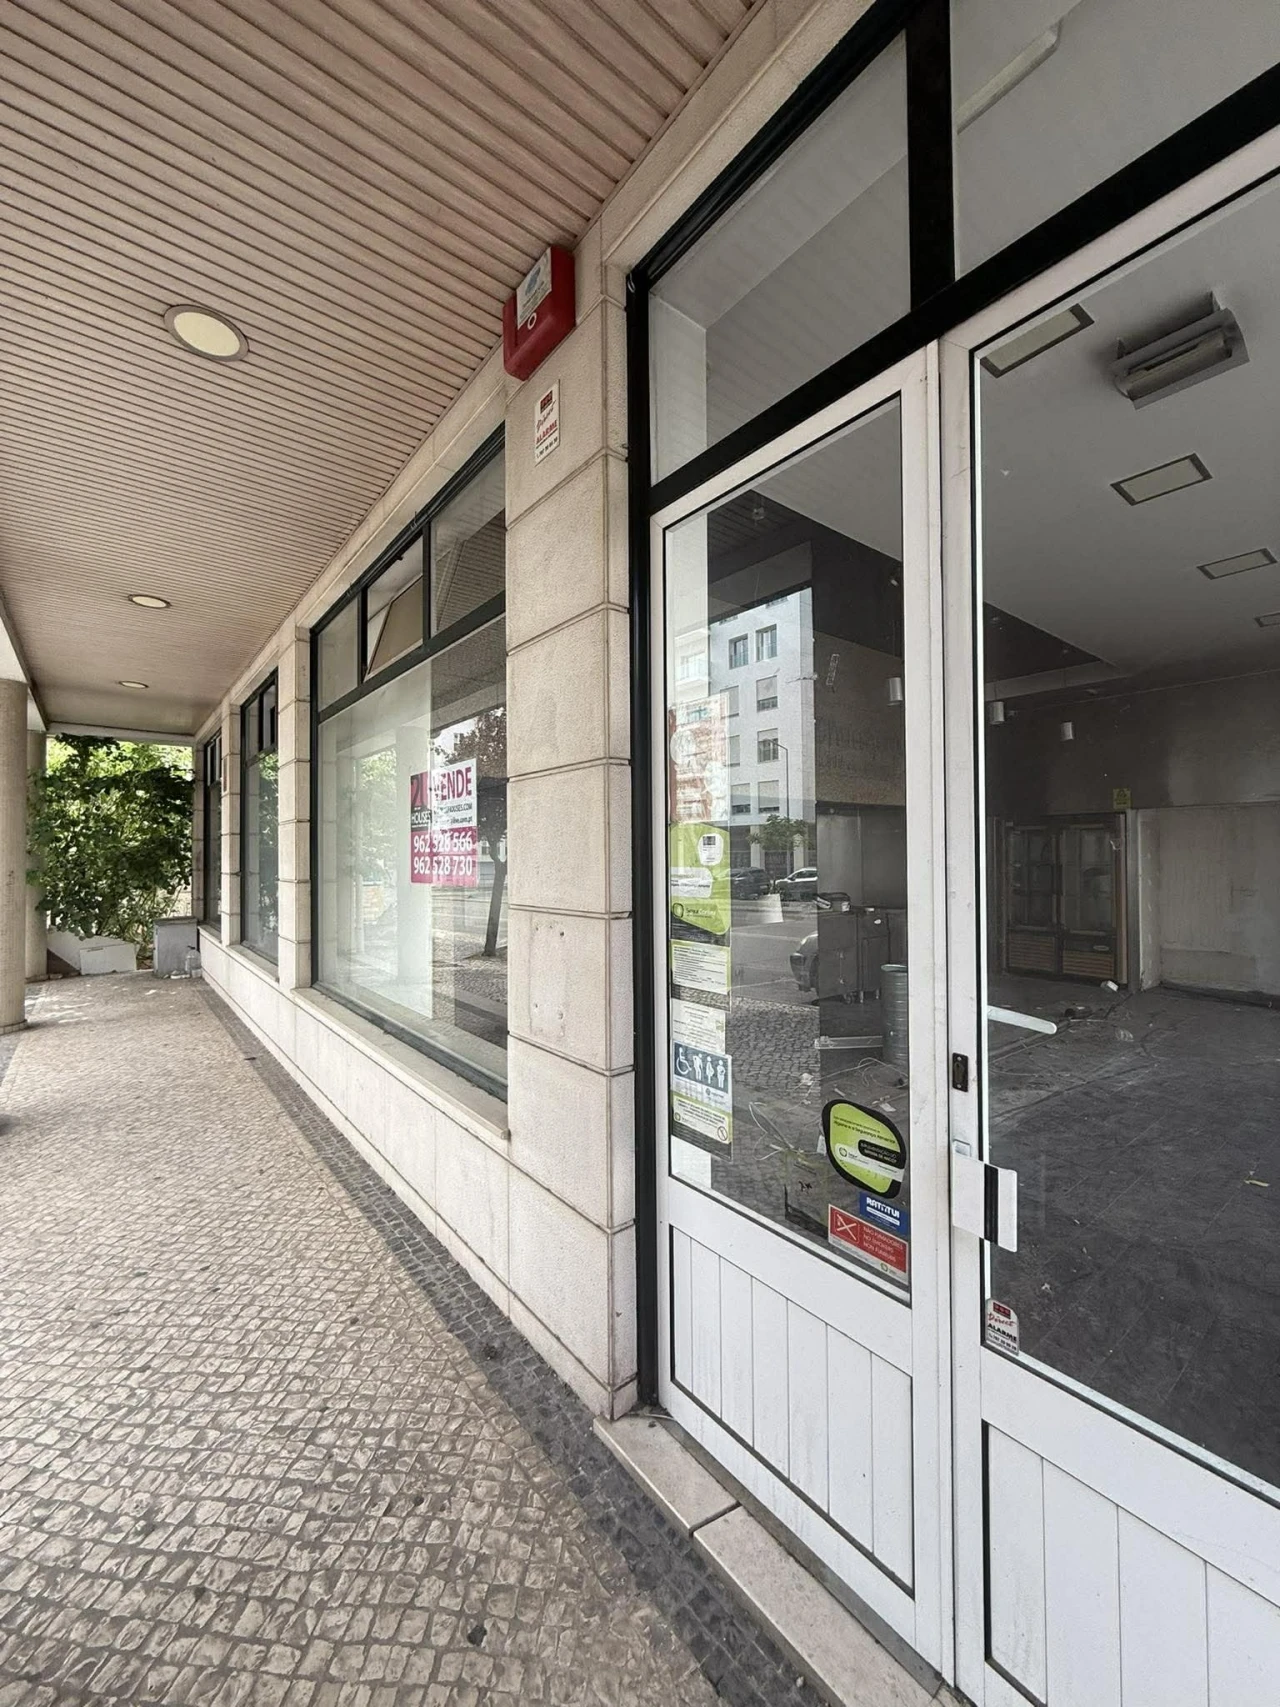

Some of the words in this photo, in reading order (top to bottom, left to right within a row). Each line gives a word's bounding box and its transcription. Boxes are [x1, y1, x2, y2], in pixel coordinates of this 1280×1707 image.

[536, 419, 558, 445] ALARME
[411, 811, 432, 825] HOUSES
[413, 835, 430, 854] 962
[453, 831, 473, 852] 566
[413, 856, 430, 875] 962
[432, 856, 451, 875] 528
[453, 855, 473, 876] 730
[987, 1323, 1017, 1343] ALARME
